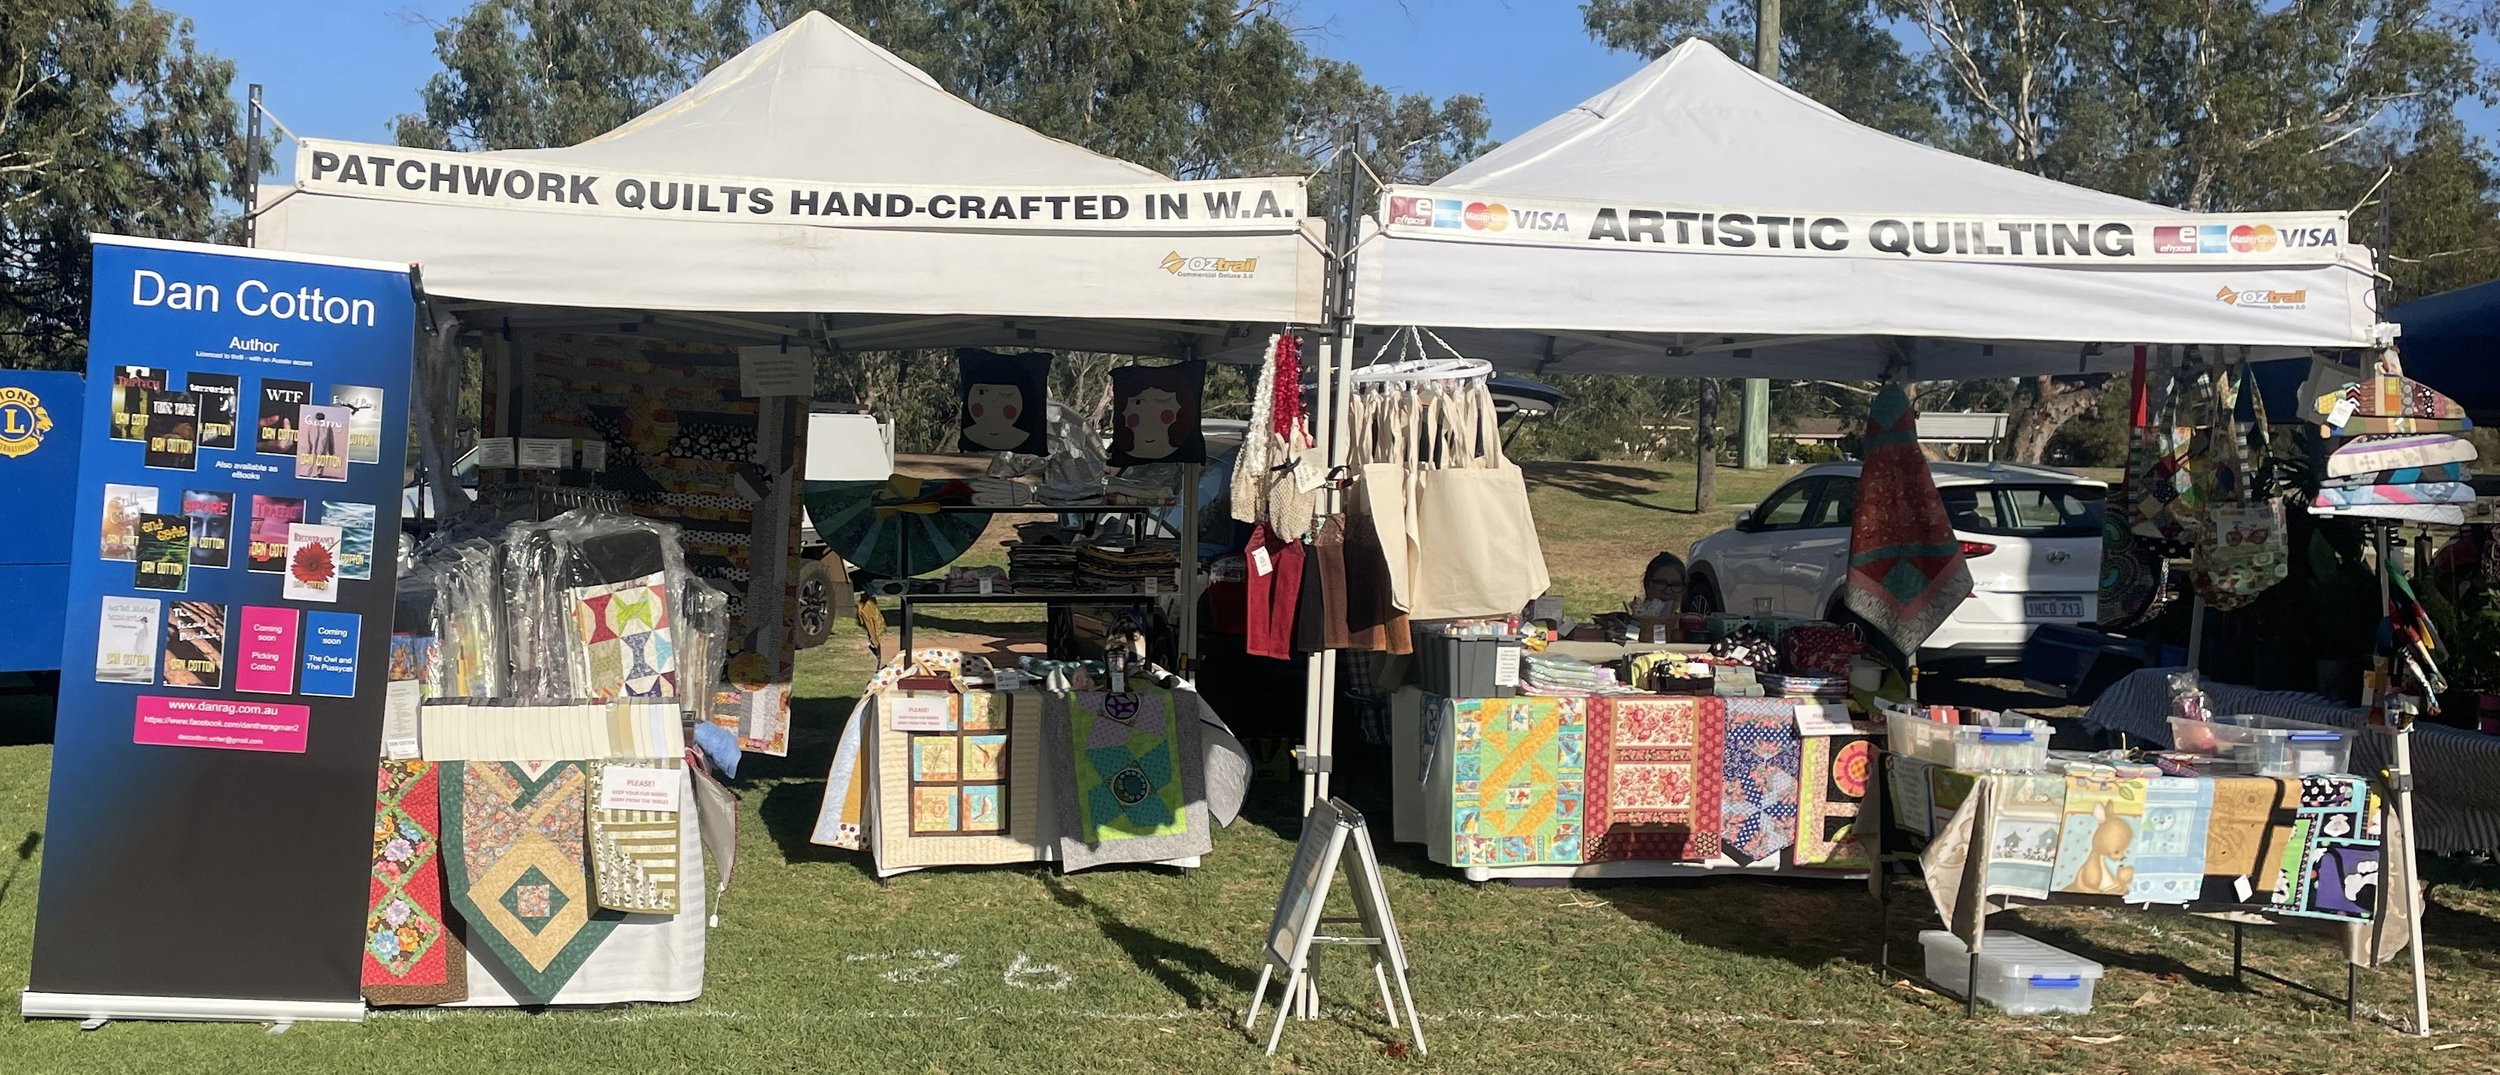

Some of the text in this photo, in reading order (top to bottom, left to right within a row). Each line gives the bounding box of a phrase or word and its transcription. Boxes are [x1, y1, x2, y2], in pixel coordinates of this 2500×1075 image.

[311, 150, 1294, 221] PATCHWORK QUILTS HAND-CRAFTED IN W.A.
[1511, 209, 1569, 232] VISA
[1587, 208, 2136, 257] ARTISTIC QUILTING
[2278, 228, 2338, 248] VISA
[132, 269, 375, 327] Dan Cotton
[229, 336, 280, 353] Author
[0, 389, 37, 407] IONS
[266, 389, 304, 403] WTF
[4, 409, 25, 433] L
[132, 413, 149, 425] COTT
[278, 428, 298, 442] COTTO
[215, 461, 232, 469] Also
[234, 462, 267, 471] available
[232, 471, 260, 480] eBooks
[183, 500, 229, 516] SPORE
[122, 535, 139, 547] COTT
[269, 543, 288, 558] COTT
[253, 624, 283, 634] Coming
[318, 627, 348, 637] Coming
[252, 652, 279, 662] Picking
[308, 654, 322, 662] The
[323, 656, 338, 664] Owl
[251, 663, 276, 671] Cotton
[306, 663, 354, 673] The Pussycat
[169, 701, 278, 716] www.danrag.com.au
[627, 780, 656, 788] PLEASE!
